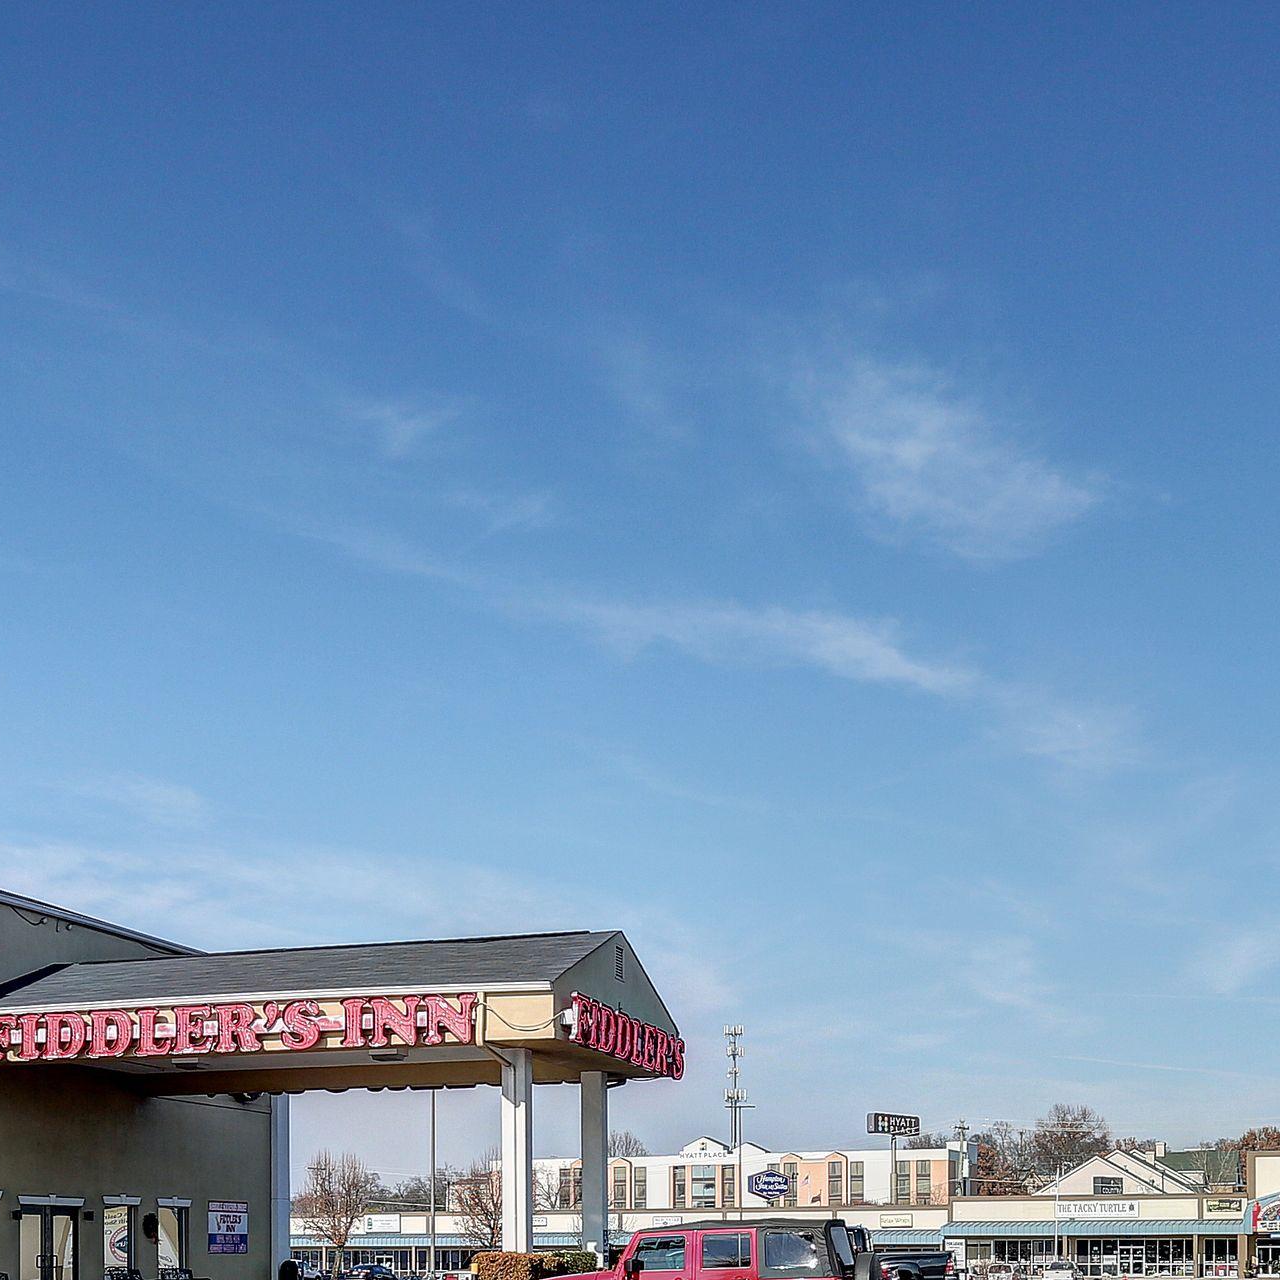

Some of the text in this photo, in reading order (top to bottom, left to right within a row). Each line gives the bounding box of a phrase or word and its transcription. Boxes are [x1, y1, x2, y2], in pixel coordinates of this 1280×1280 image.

[340, 991, 479, 1048] INN
[570, 992, 685, 1080] FIDDLER'S
[890, 1117, 916, 1127] HYATT
[1057, 1202, 1126, 1212] THE TACKY TURTLE
